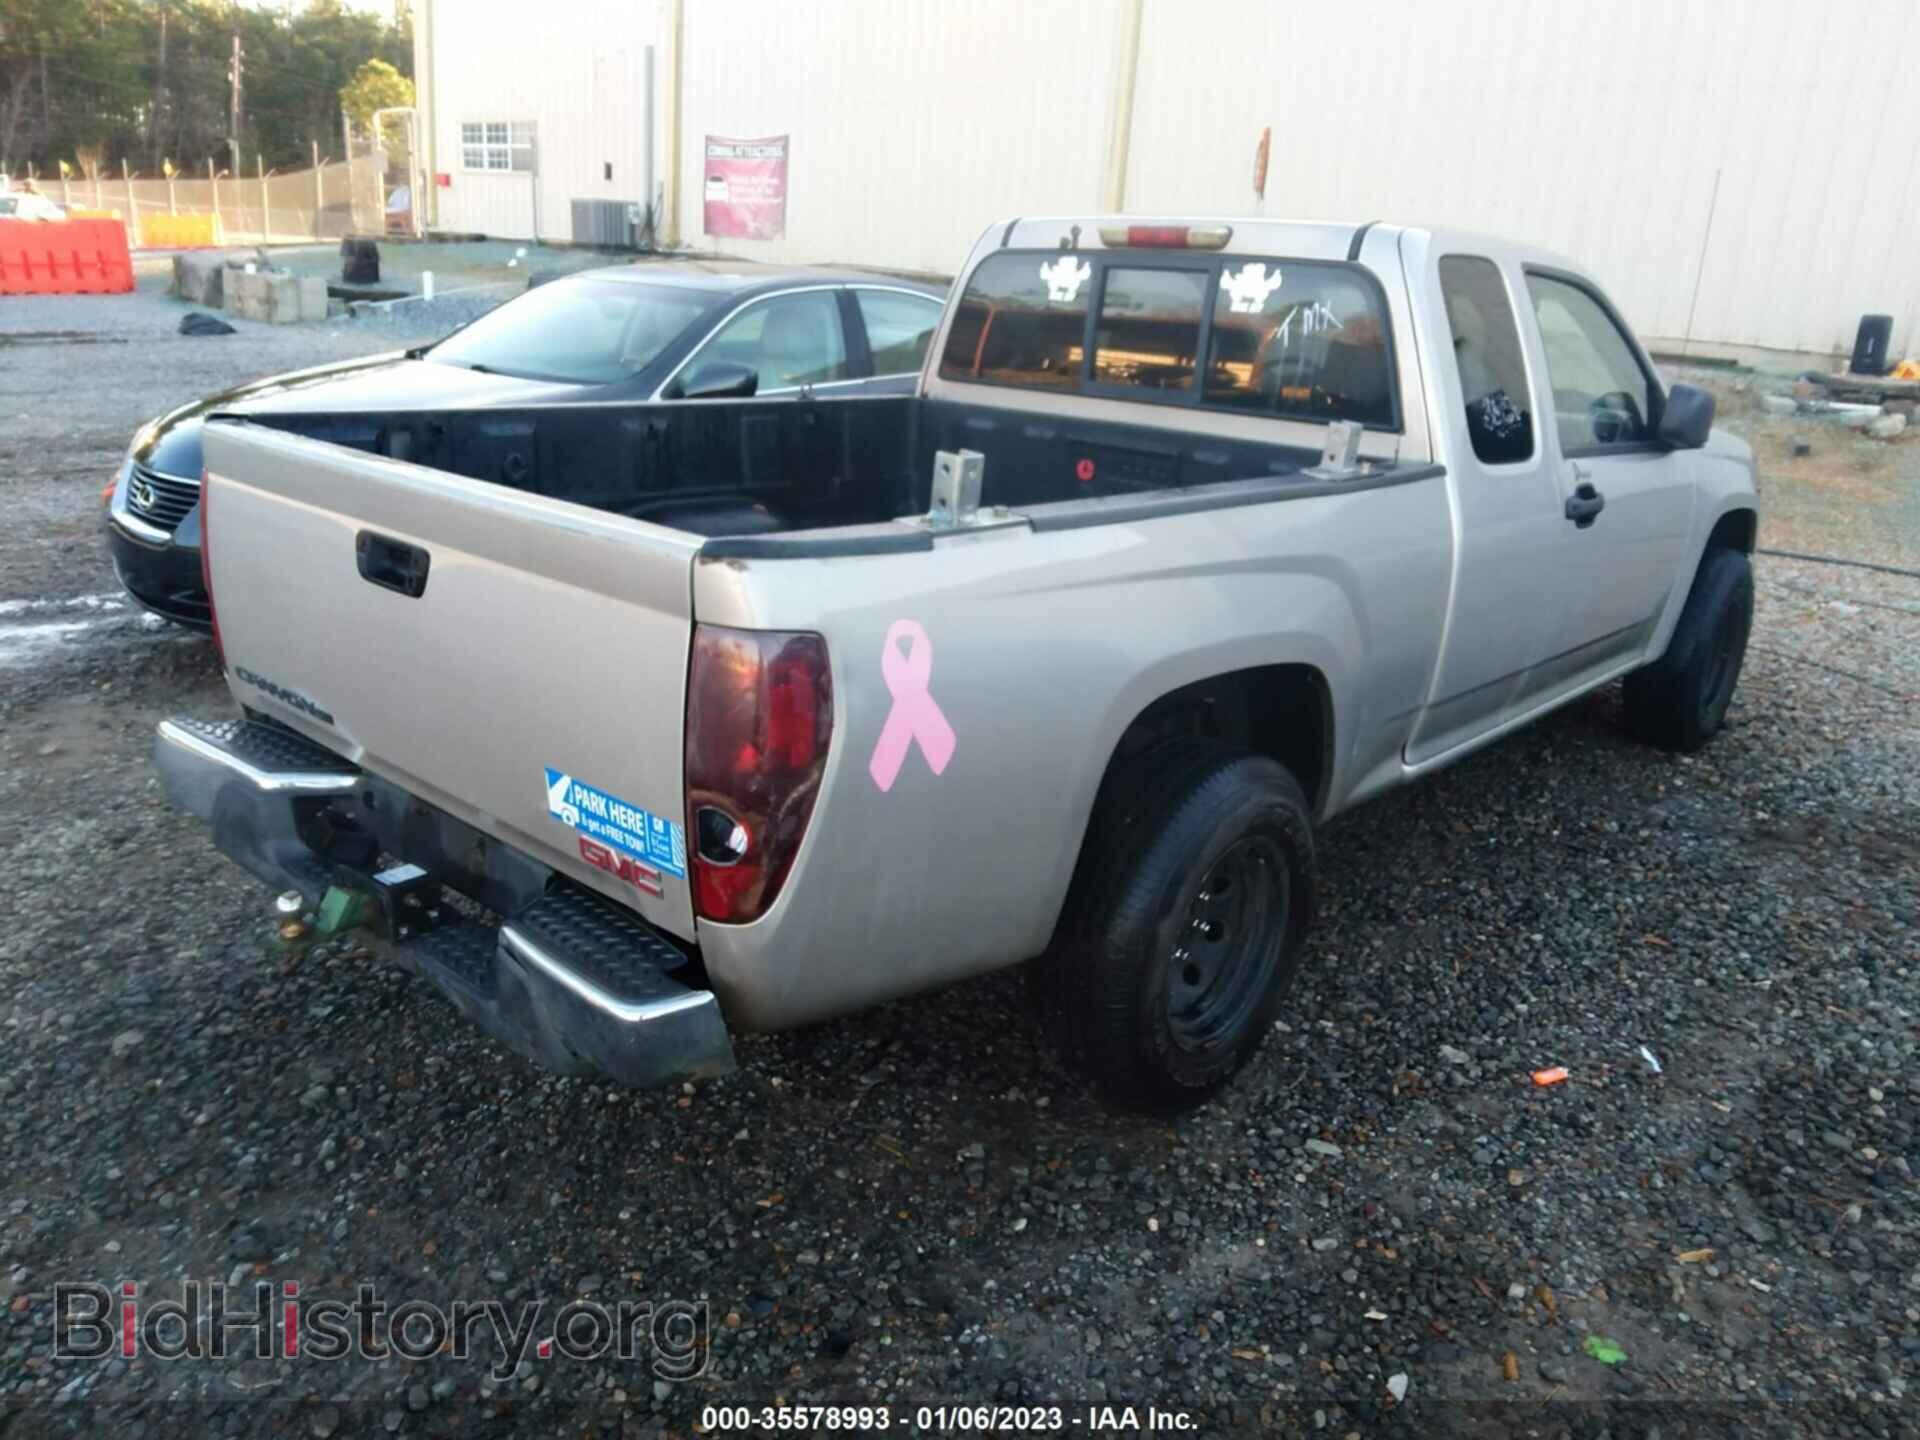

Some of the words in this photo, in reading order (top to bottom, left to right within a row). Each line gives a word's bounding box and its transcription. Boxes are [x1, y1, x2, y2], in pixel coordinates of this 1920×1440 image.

[573, 784, 608, 819] PARK
[609, 800, 645, 836] HERE
[605, 823, 625, 845] FREE
[578, 834, 665, 899] GMC
